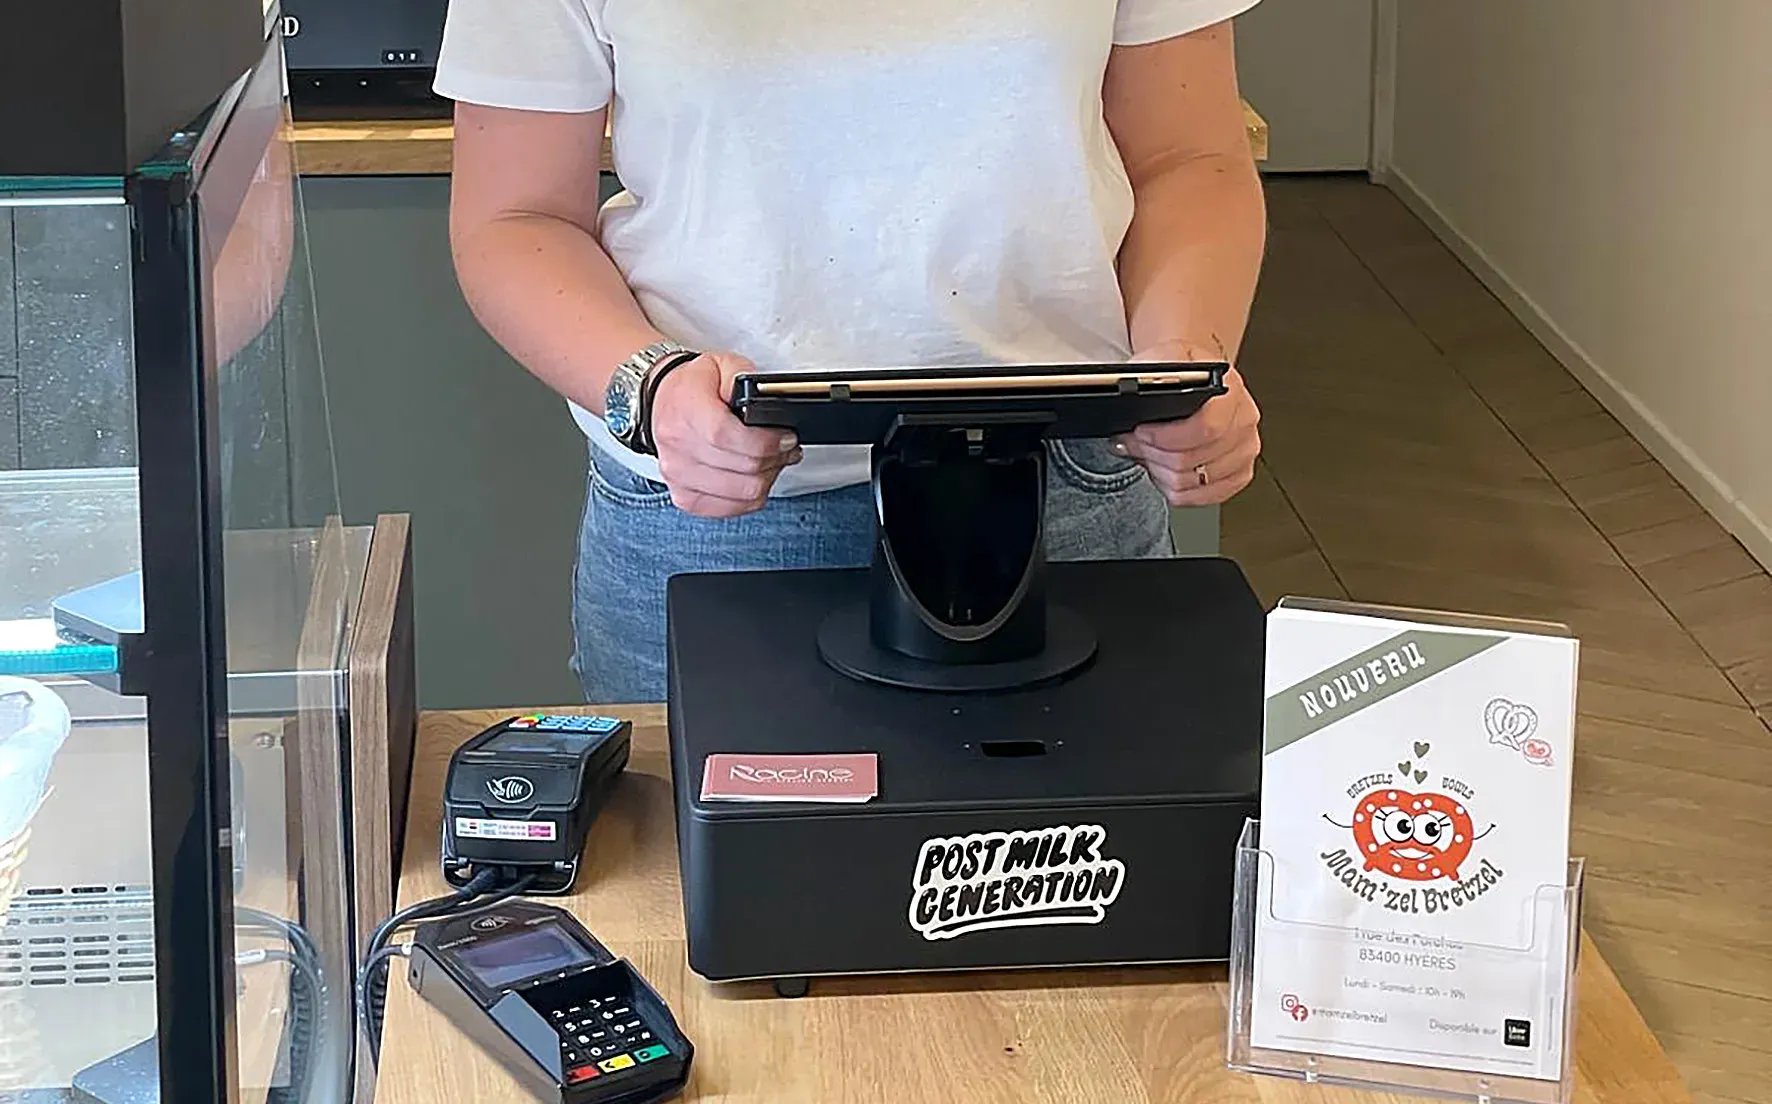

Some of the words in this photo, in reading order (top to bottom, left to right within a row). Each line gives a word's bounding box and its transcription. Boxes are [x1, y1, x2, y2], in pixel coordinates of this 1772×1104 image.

[919, 838, 1005, 886] POST
[1003, 830, 1100, 873] MILK
[1320, 847, 1419, 914] Mam'zel
[1425, 858, 1505, 914] Bretzel
[915, 864, 1120, 926] GENERATION
[1359, 948, 1401, 965] 83400
